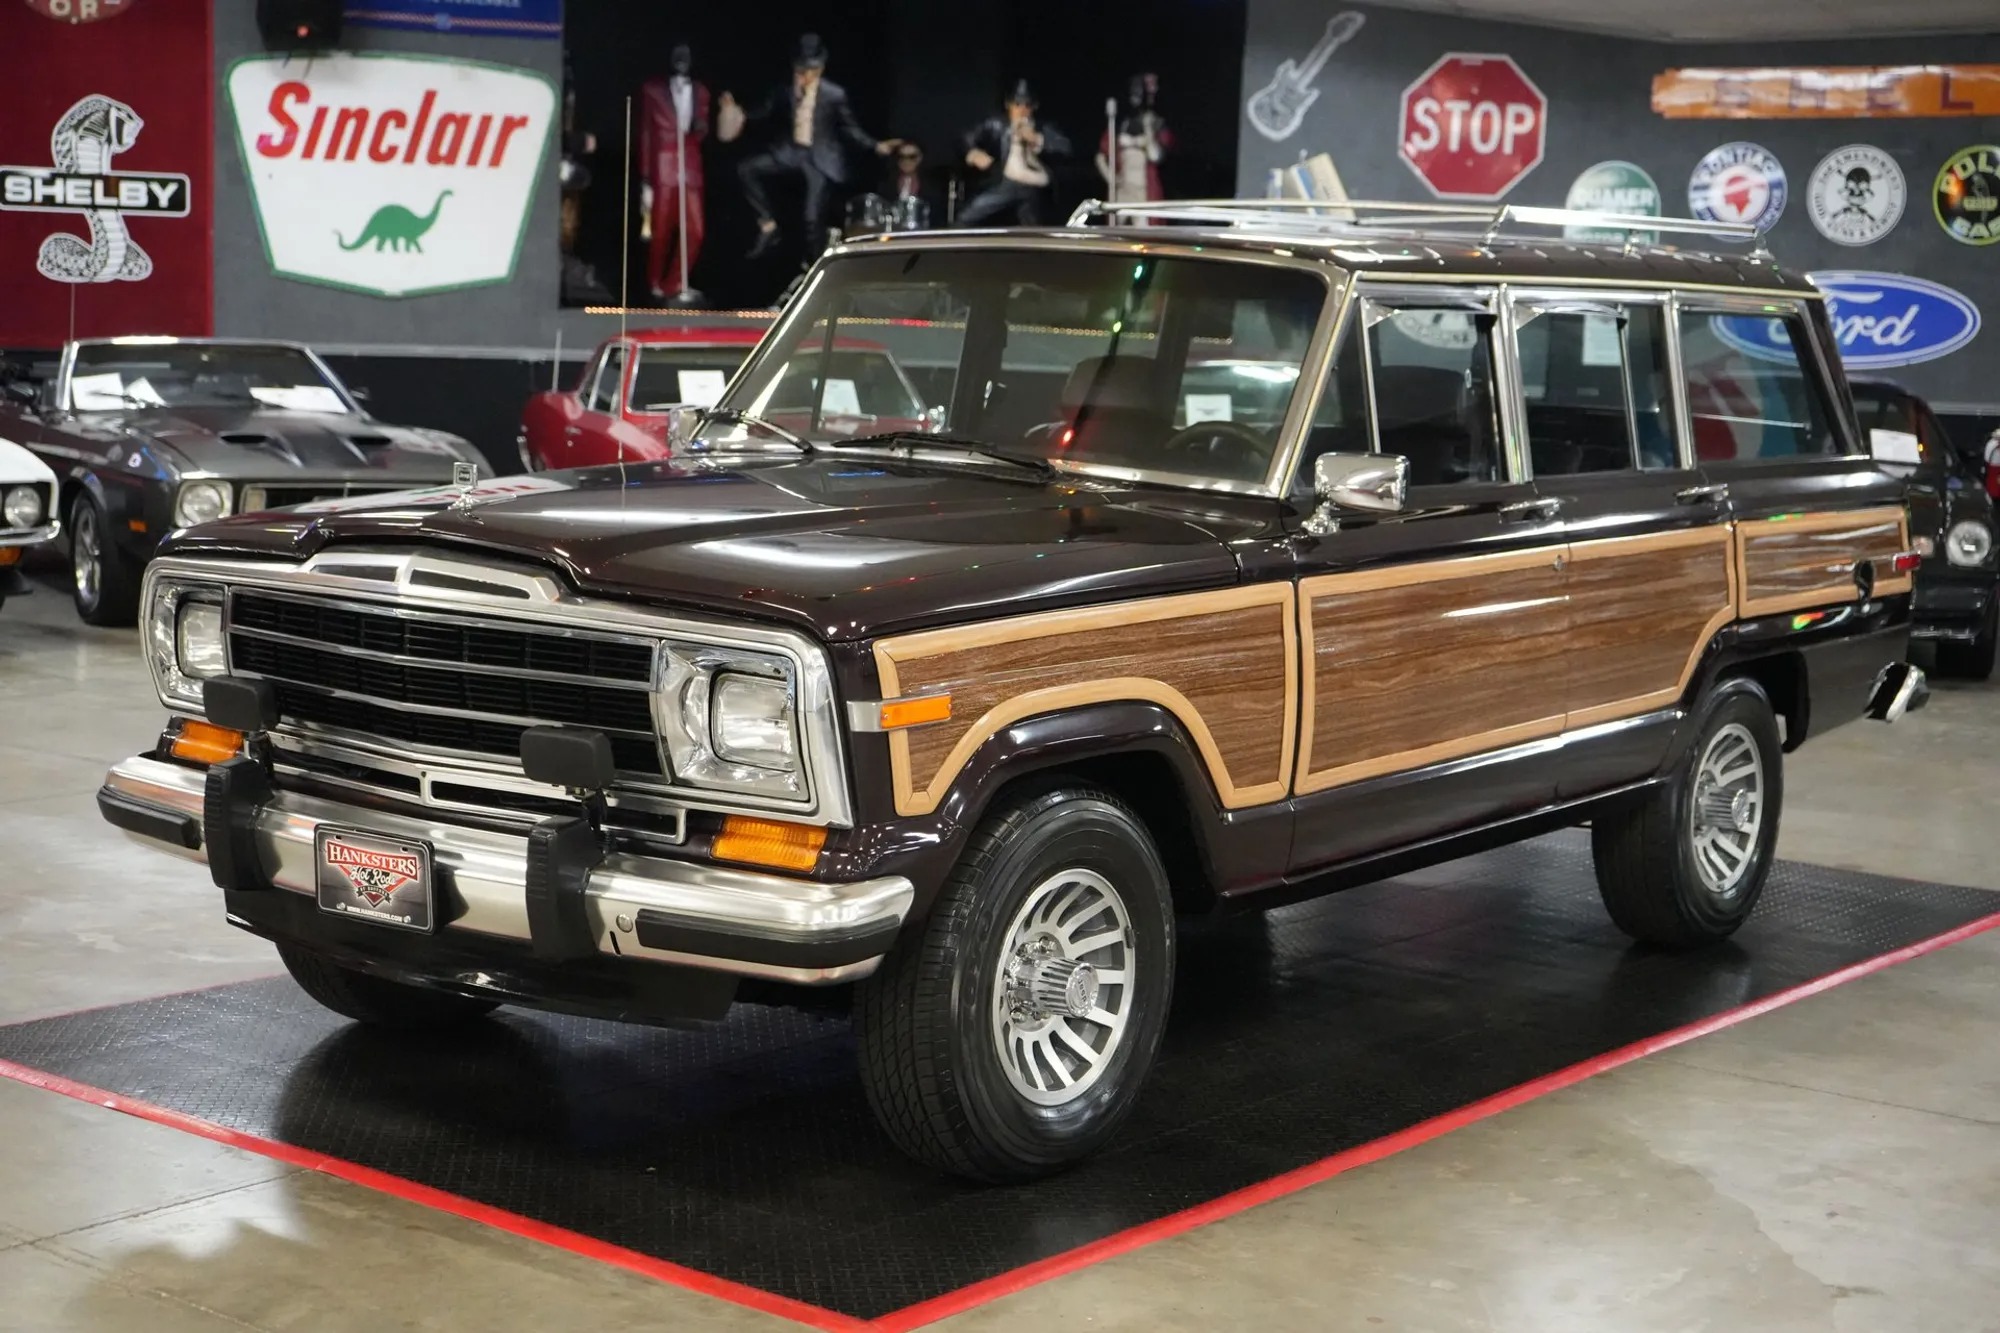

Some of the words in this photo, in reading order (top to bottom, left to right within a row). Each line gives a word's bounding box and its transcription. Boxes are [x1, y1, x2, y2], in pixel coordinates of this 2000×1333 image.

[256, 81, 529, 168] Sinclair
[1411, 97, 1536, 155] STOP
[1695, 146, 1783, 184] PONTIAC
[1939, 151, 2000, 195] POL
[4, 175, 179, 208] SHELBY
[1573, 187, 1655, 207] QUAKER
[328, 844, 417, 876] HANKSTERS
[349, 866, 370, 882] Hot
